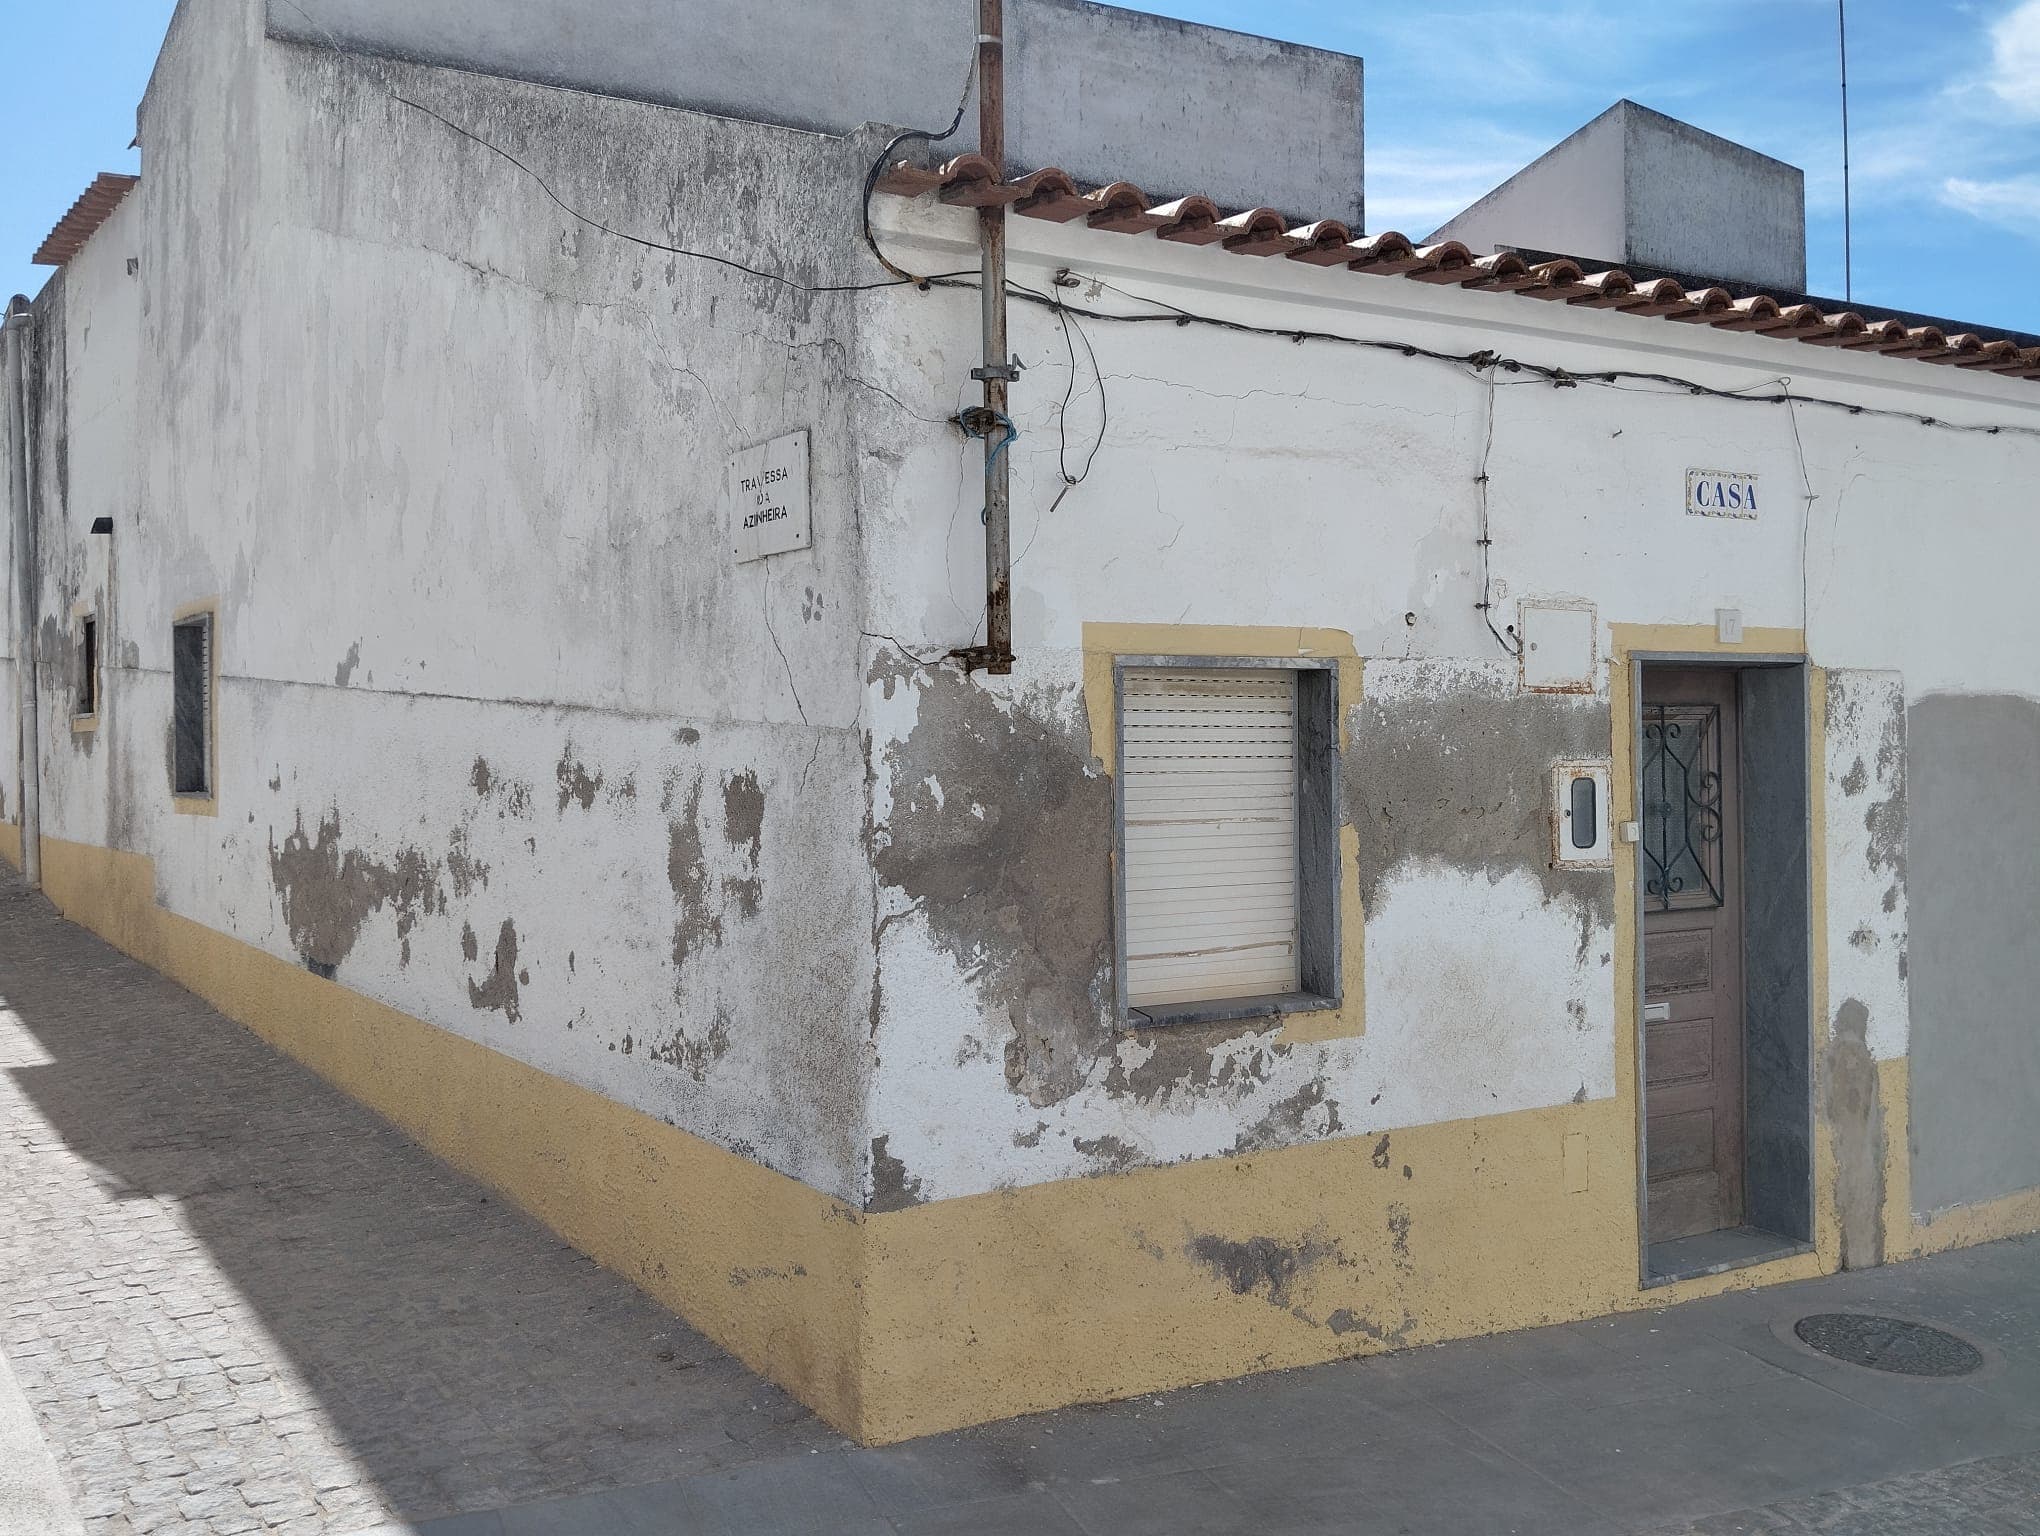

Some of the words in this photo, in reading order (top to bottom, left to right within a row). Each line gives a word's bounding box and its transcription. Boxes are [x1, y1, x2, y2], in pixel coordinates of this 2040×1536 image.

[741, 467, 788, 493] TRAVESSA
[1696, 481, 1757, 510] CASA
[743, 505, 788, 529] AZINHEIRA
